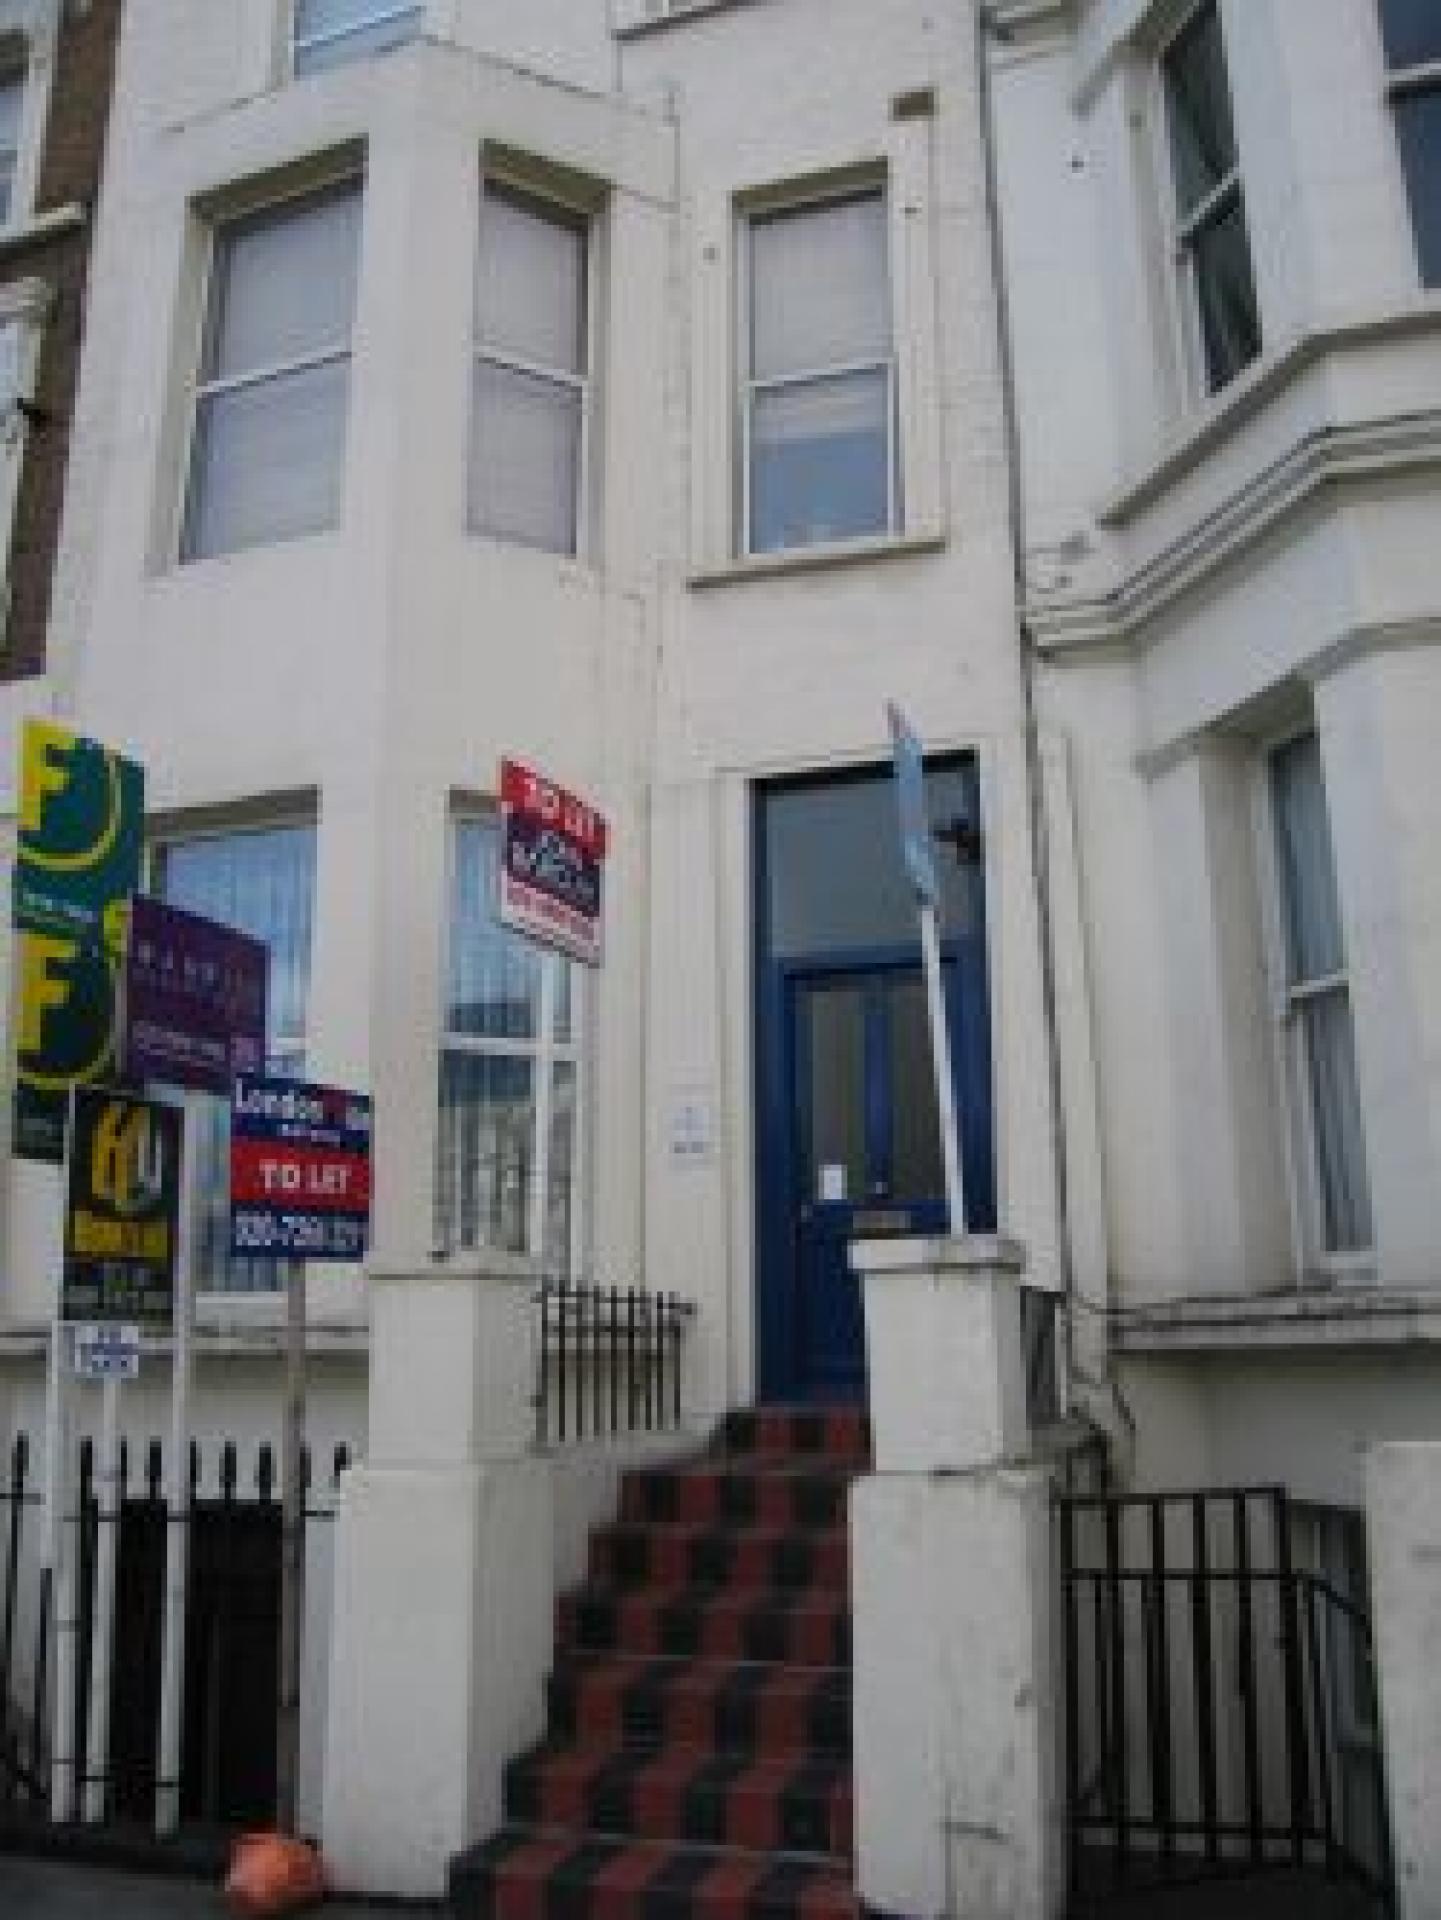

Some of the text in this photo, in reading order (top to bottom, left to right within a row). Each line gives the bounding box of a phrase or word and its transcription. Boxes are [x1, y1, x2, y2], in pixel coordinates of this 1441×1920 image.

[235, 1078, 324, 1122] London
[258, 1158, 352, 1195] TO LET
